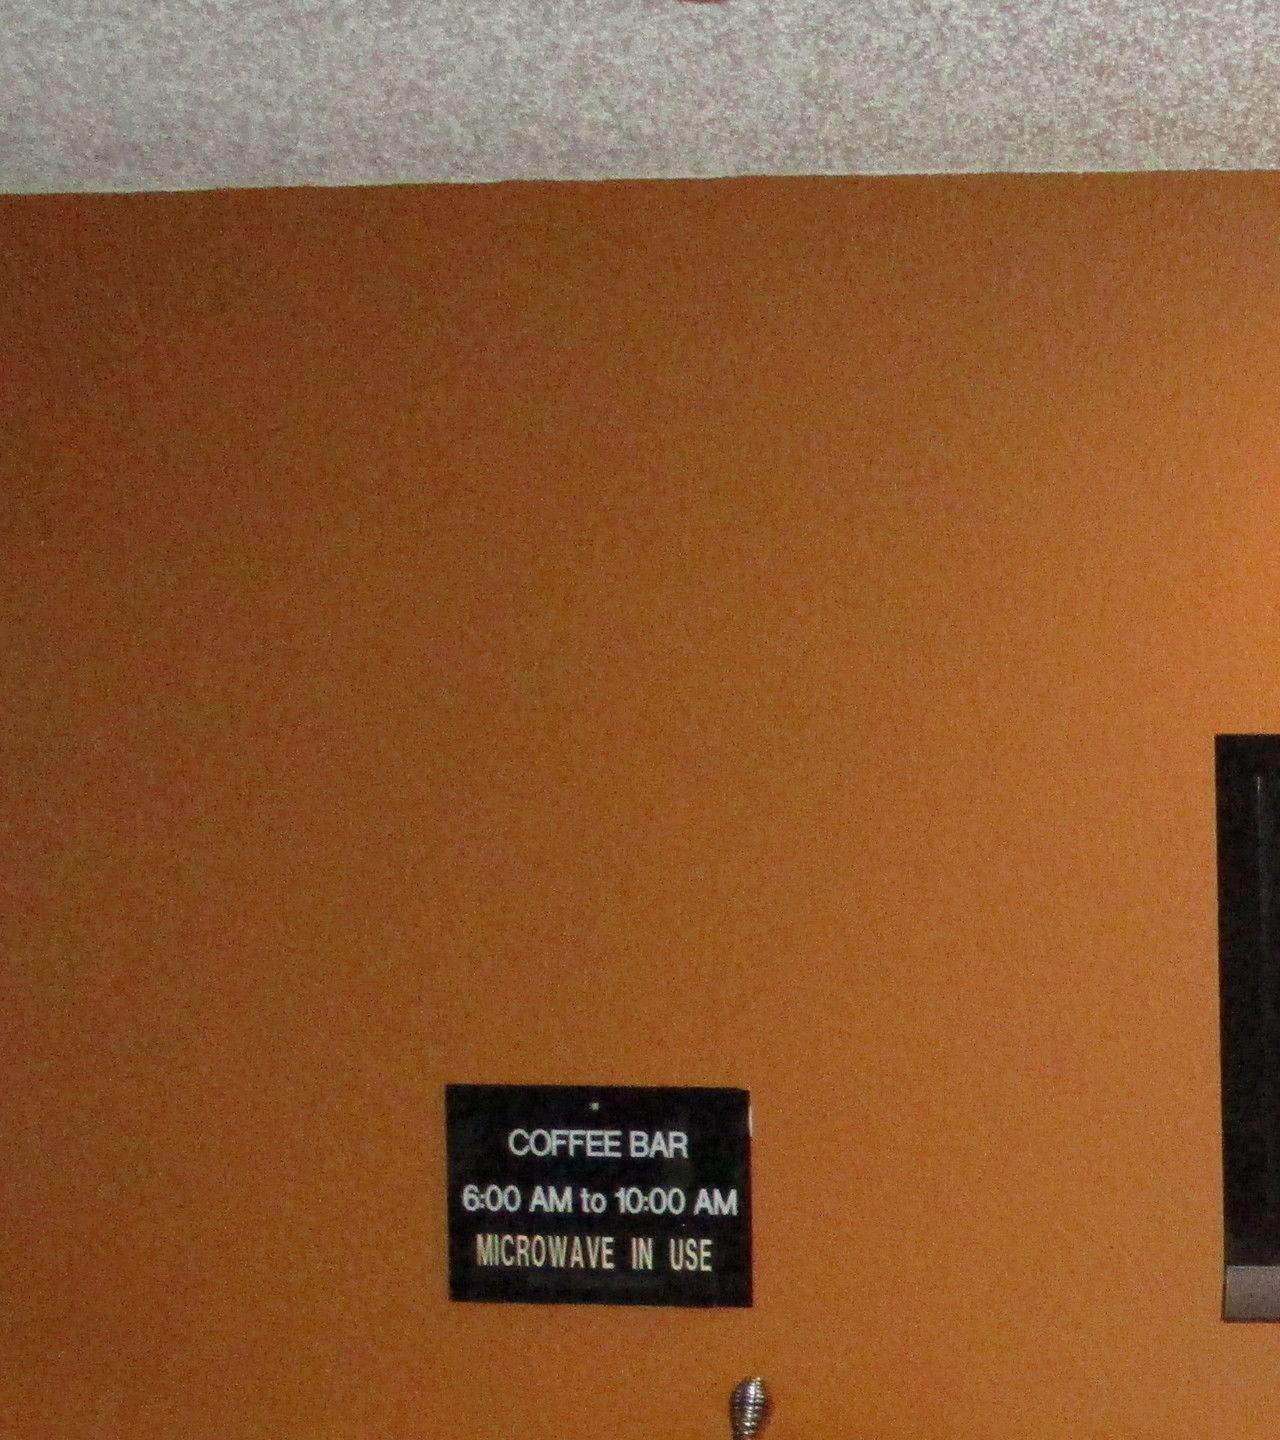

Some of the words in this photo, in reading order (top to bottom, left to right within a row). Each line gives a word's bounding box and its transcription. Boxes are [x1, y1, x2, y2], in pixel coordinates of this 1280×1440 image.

[508, 1128, 623, 1157] COFFEE
[629, 1130, 689, 1158] BAR
[462, 1184, 521, 1212] 6:00
[529, 1186, 573, 1214] AM
[580, 1187, 607, 1214] to
[615, 1187, 686, 1215] 10:00
[693, 1188, 739, 1216] AM
[475, 1233, 615, 1269] MICROWAVE
[631, 1237, 654, 1270] IN
[670, 1238, 713, 1272] USE
